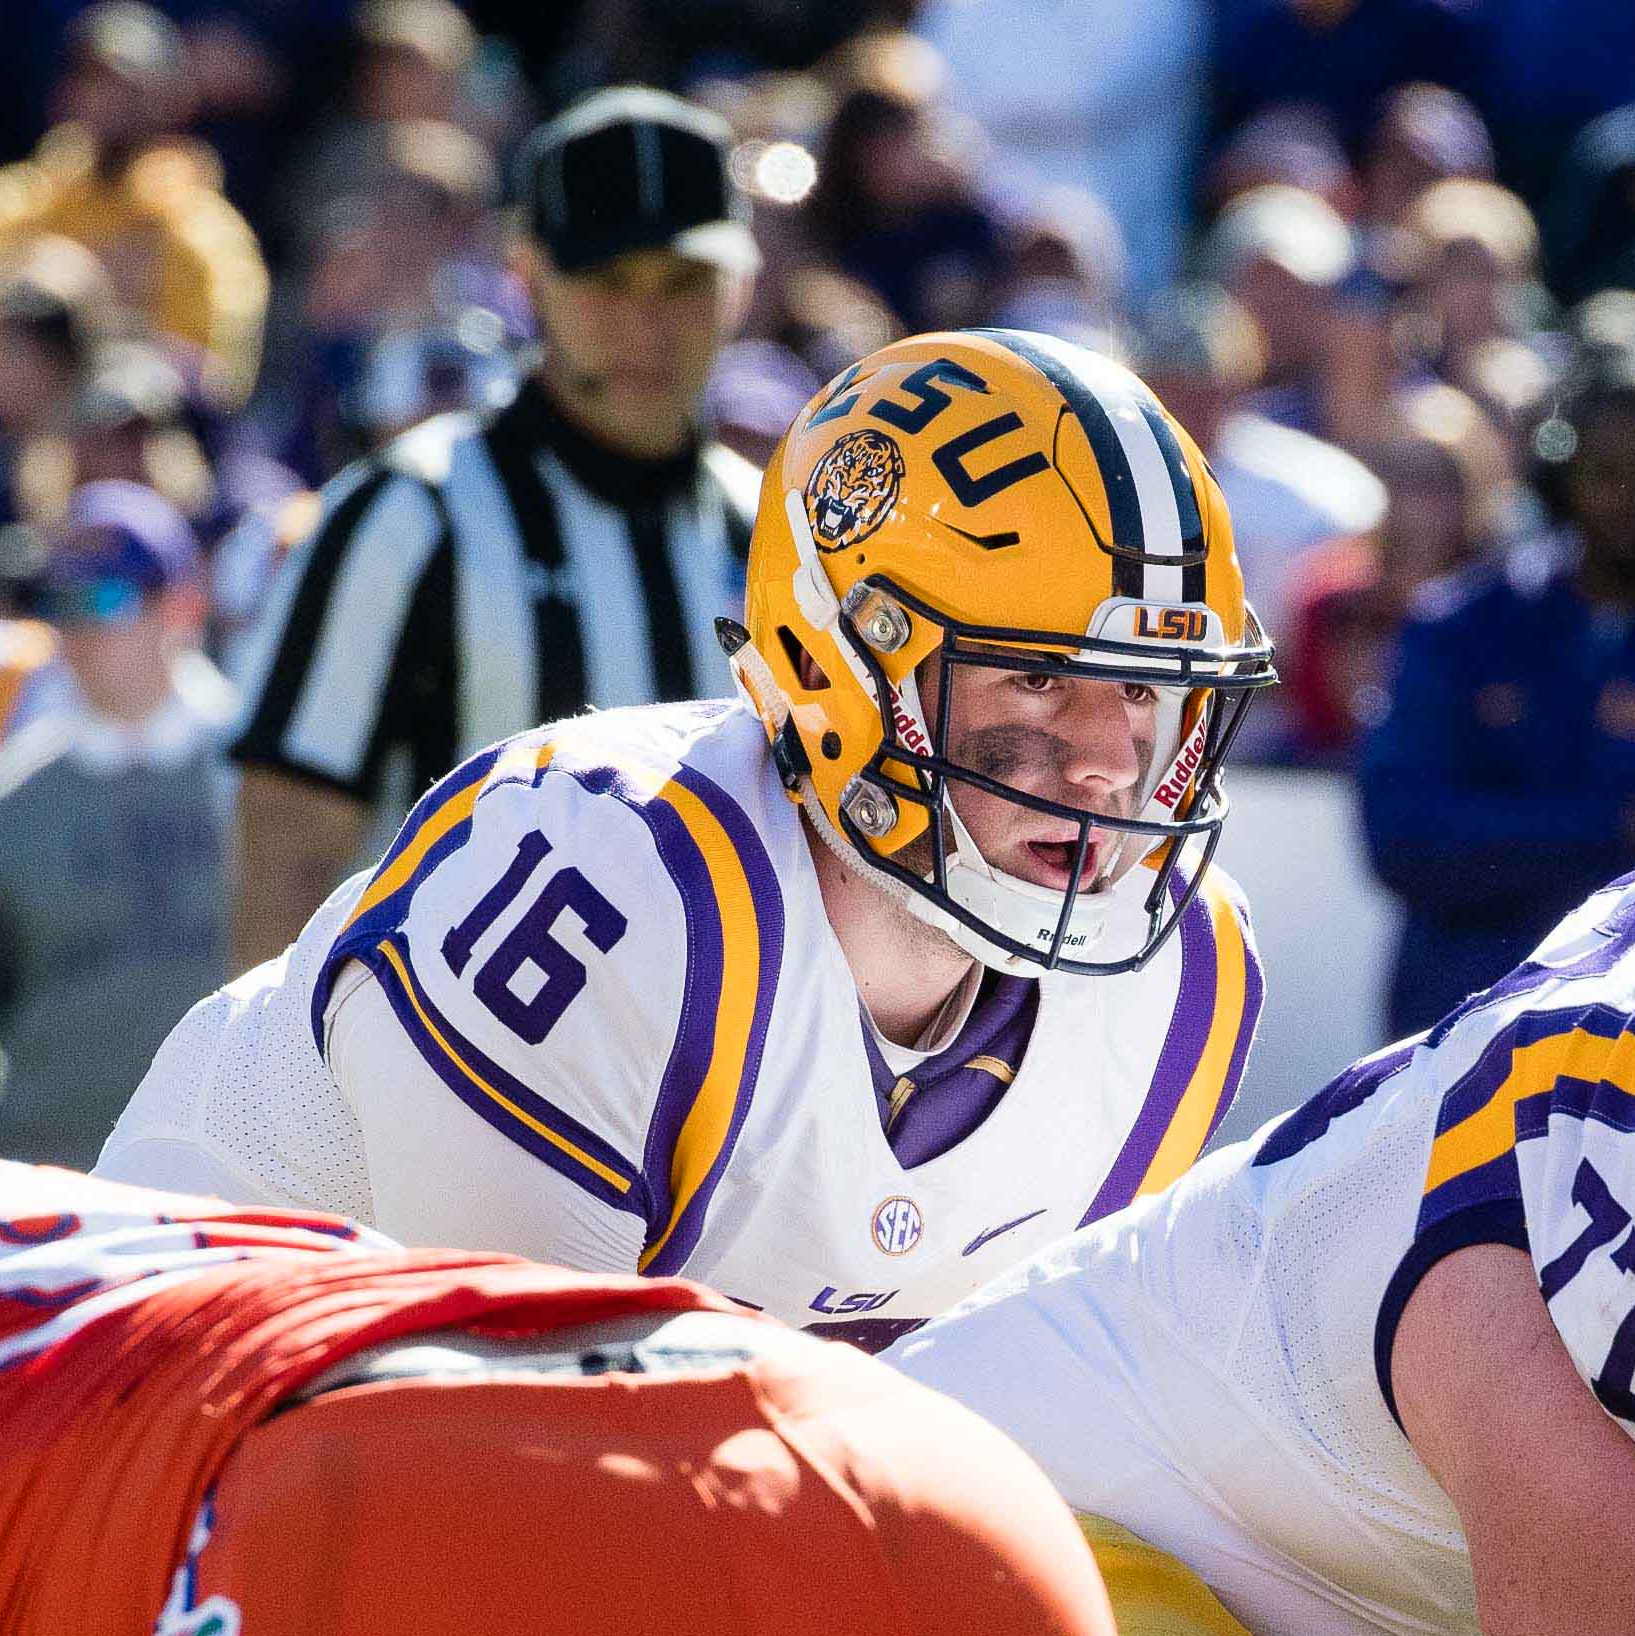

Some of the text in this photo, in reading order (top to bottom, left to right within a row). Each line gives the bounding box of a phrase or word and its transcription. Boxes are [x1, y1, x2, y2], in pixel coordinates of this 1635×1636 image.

[804, 357, 1051, 508] LSU
[1133, 606, 1208, 642] LSU
[440, 829, 628, 1046] 16
[1036, 928, 1087, 946] Ridell
[873, 1198, 923, 1253] SEC
[807, 1286, 901, 1315] LSU
